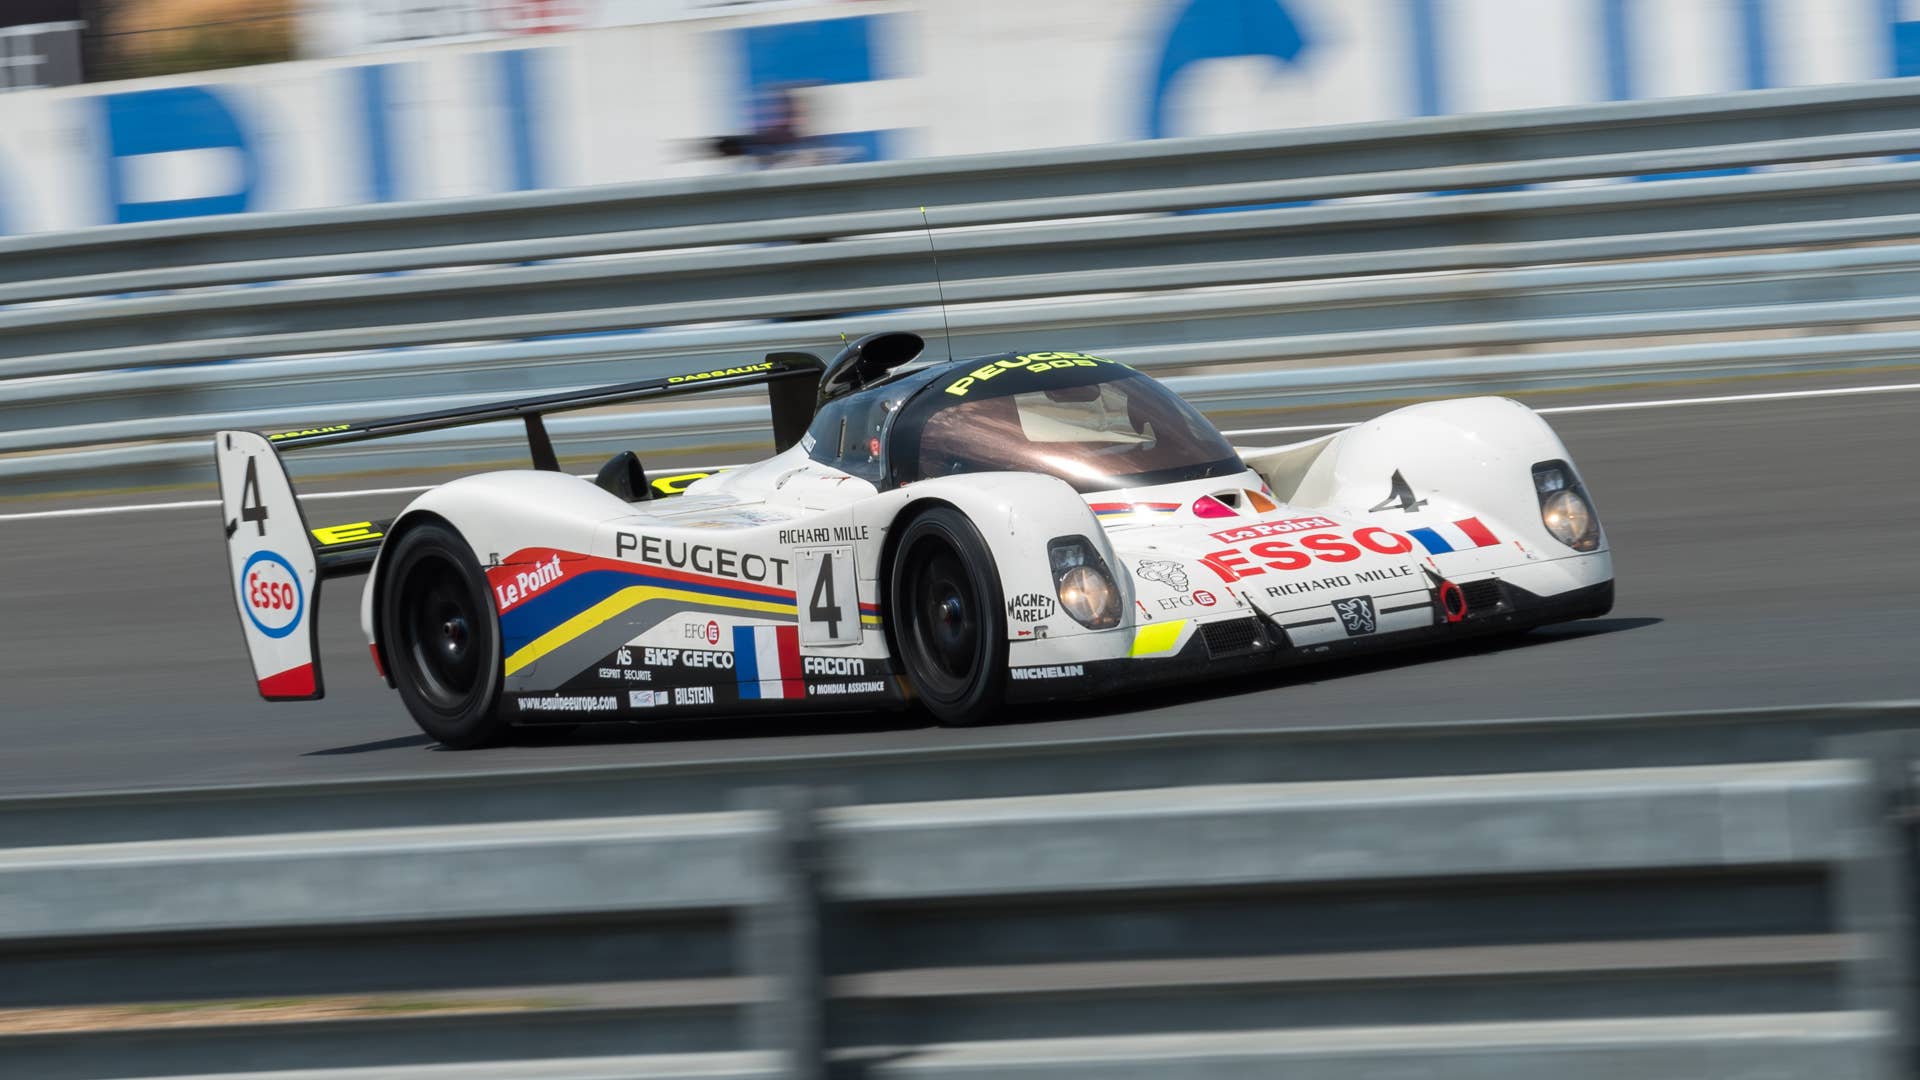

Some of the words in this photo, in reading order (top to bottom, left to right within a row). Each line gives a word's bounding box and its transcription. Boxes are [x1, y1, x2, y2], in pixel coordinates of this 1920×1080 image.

[668, 362, 773, 383] DASSAULT
[945, 351, 1136, 396] PEUGE
[1026, 359, 1099, 373] 905
[241, 456, 268, 536] 4
[1368, 468, 1428, 513] 4
[779, 528, 830, 544] RICHARD
[833, 525, 869, 542] MILLE
[1217, 529, 1252, 543] Le
[1250, 516, 1333, 536] Point
[616, 531, 789, 586] PEUGEOT
[1198, 526, 1413, 583] ESSO
[496, 584, 519, 609] Le
[516, 553, 563, 598] Point
[1266, 575, 1351, 597] RICHARD
[1355, 565, 1414, 584] MILLE
[809, 553, 842, 639] 4
[1007, 593, 1055, 616] MAGNETI
[1158, 595, 1194, 610] EFG
[684, 623, 706, 639] EFG
[644, 648, 680, 666] SKF
[682, 650, 734, 669] GEFCO
[804, 657, 865, 676] FACOM
[1011, 665, 1084, 679] MICHELIN
[674, 686, 714, 706] BILSTEIN
[816, 683, 847, 695] MONDIAL
[848, 681, 885, 694] ASSISTANCE
